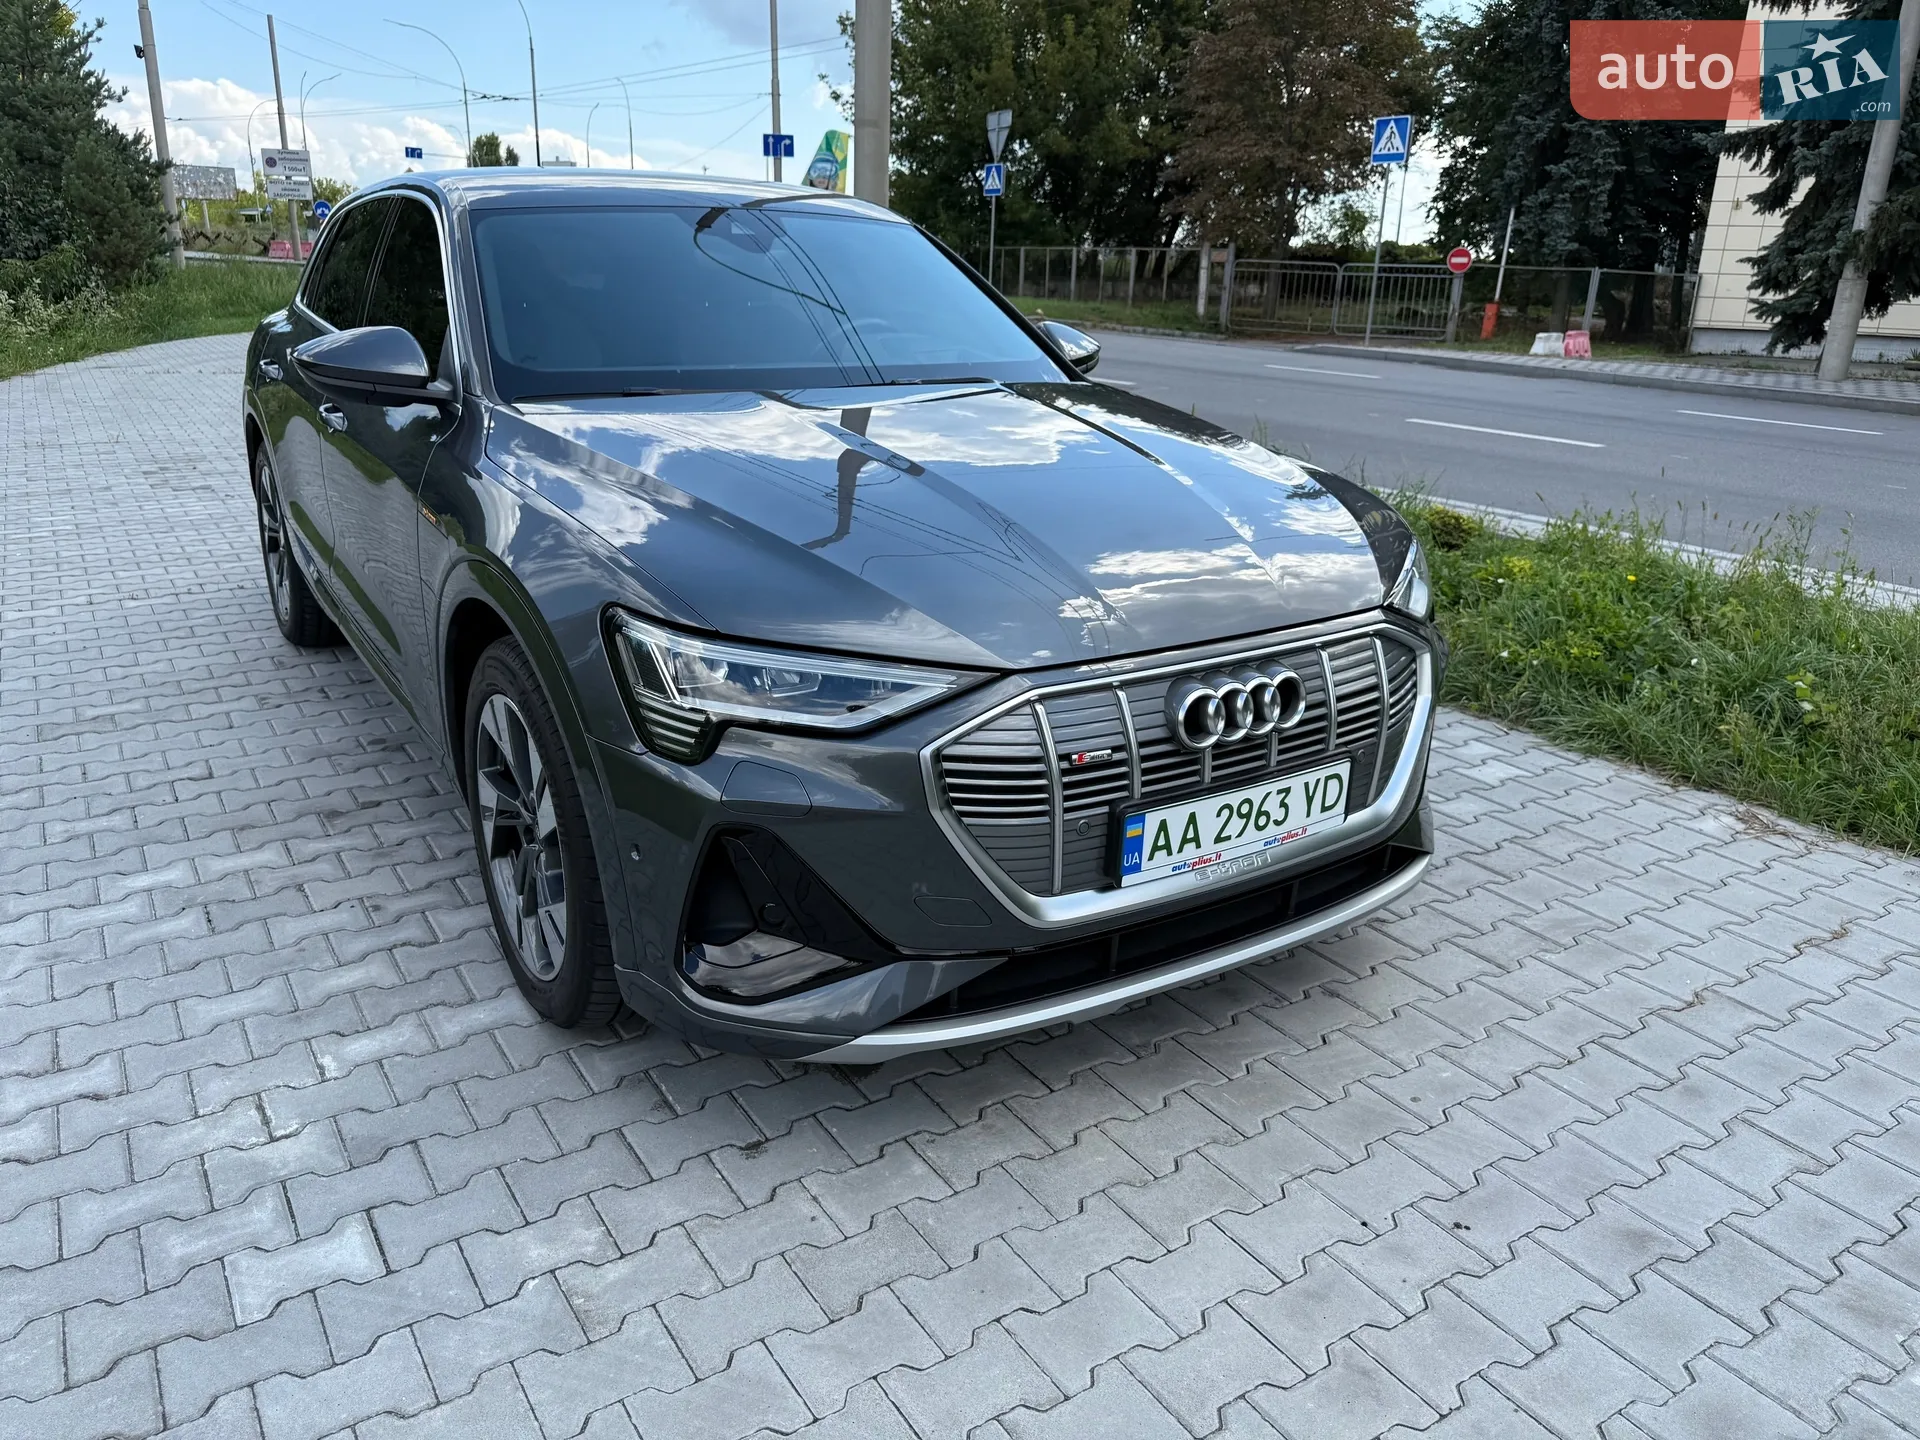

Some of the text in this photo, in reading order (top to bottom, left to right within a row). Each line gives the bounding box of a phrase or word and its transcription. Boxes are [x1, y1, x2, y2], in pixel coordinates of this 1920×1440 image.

[1148, 772, 1344, 862] AA 2963 YD
[1124, 852, 1140, 867] UA
